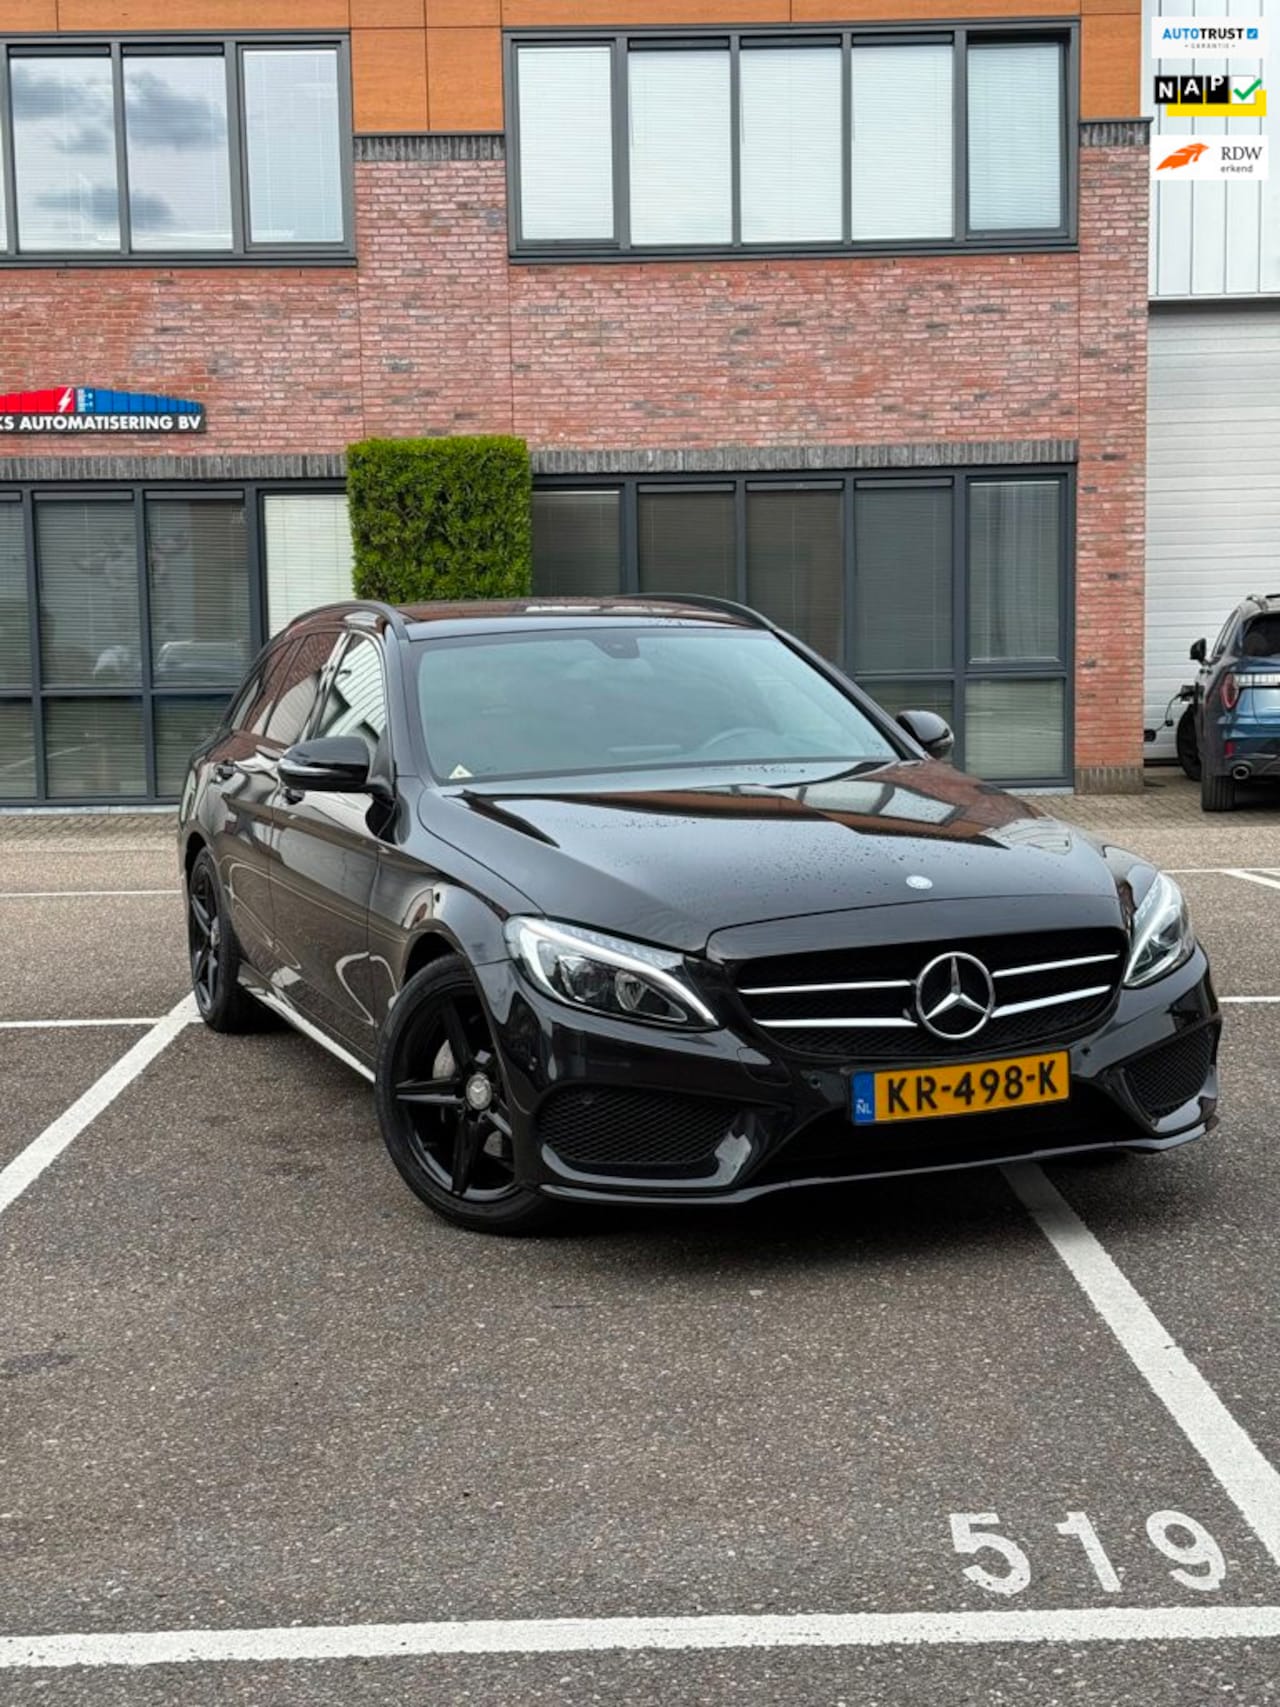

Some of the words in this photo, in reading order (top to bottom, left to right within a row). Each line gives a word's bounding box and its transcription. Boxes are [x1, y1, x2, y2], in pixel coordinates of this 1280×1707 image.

[19, 415, 173, 430] AUTOMATISERING
[178, 415, 201, 430] BV
[856, 1102, 872, 1114] NL
[887, 1060, 1058, 1114] KR-498-K
[949, 1509, 1226, 1597] 519
